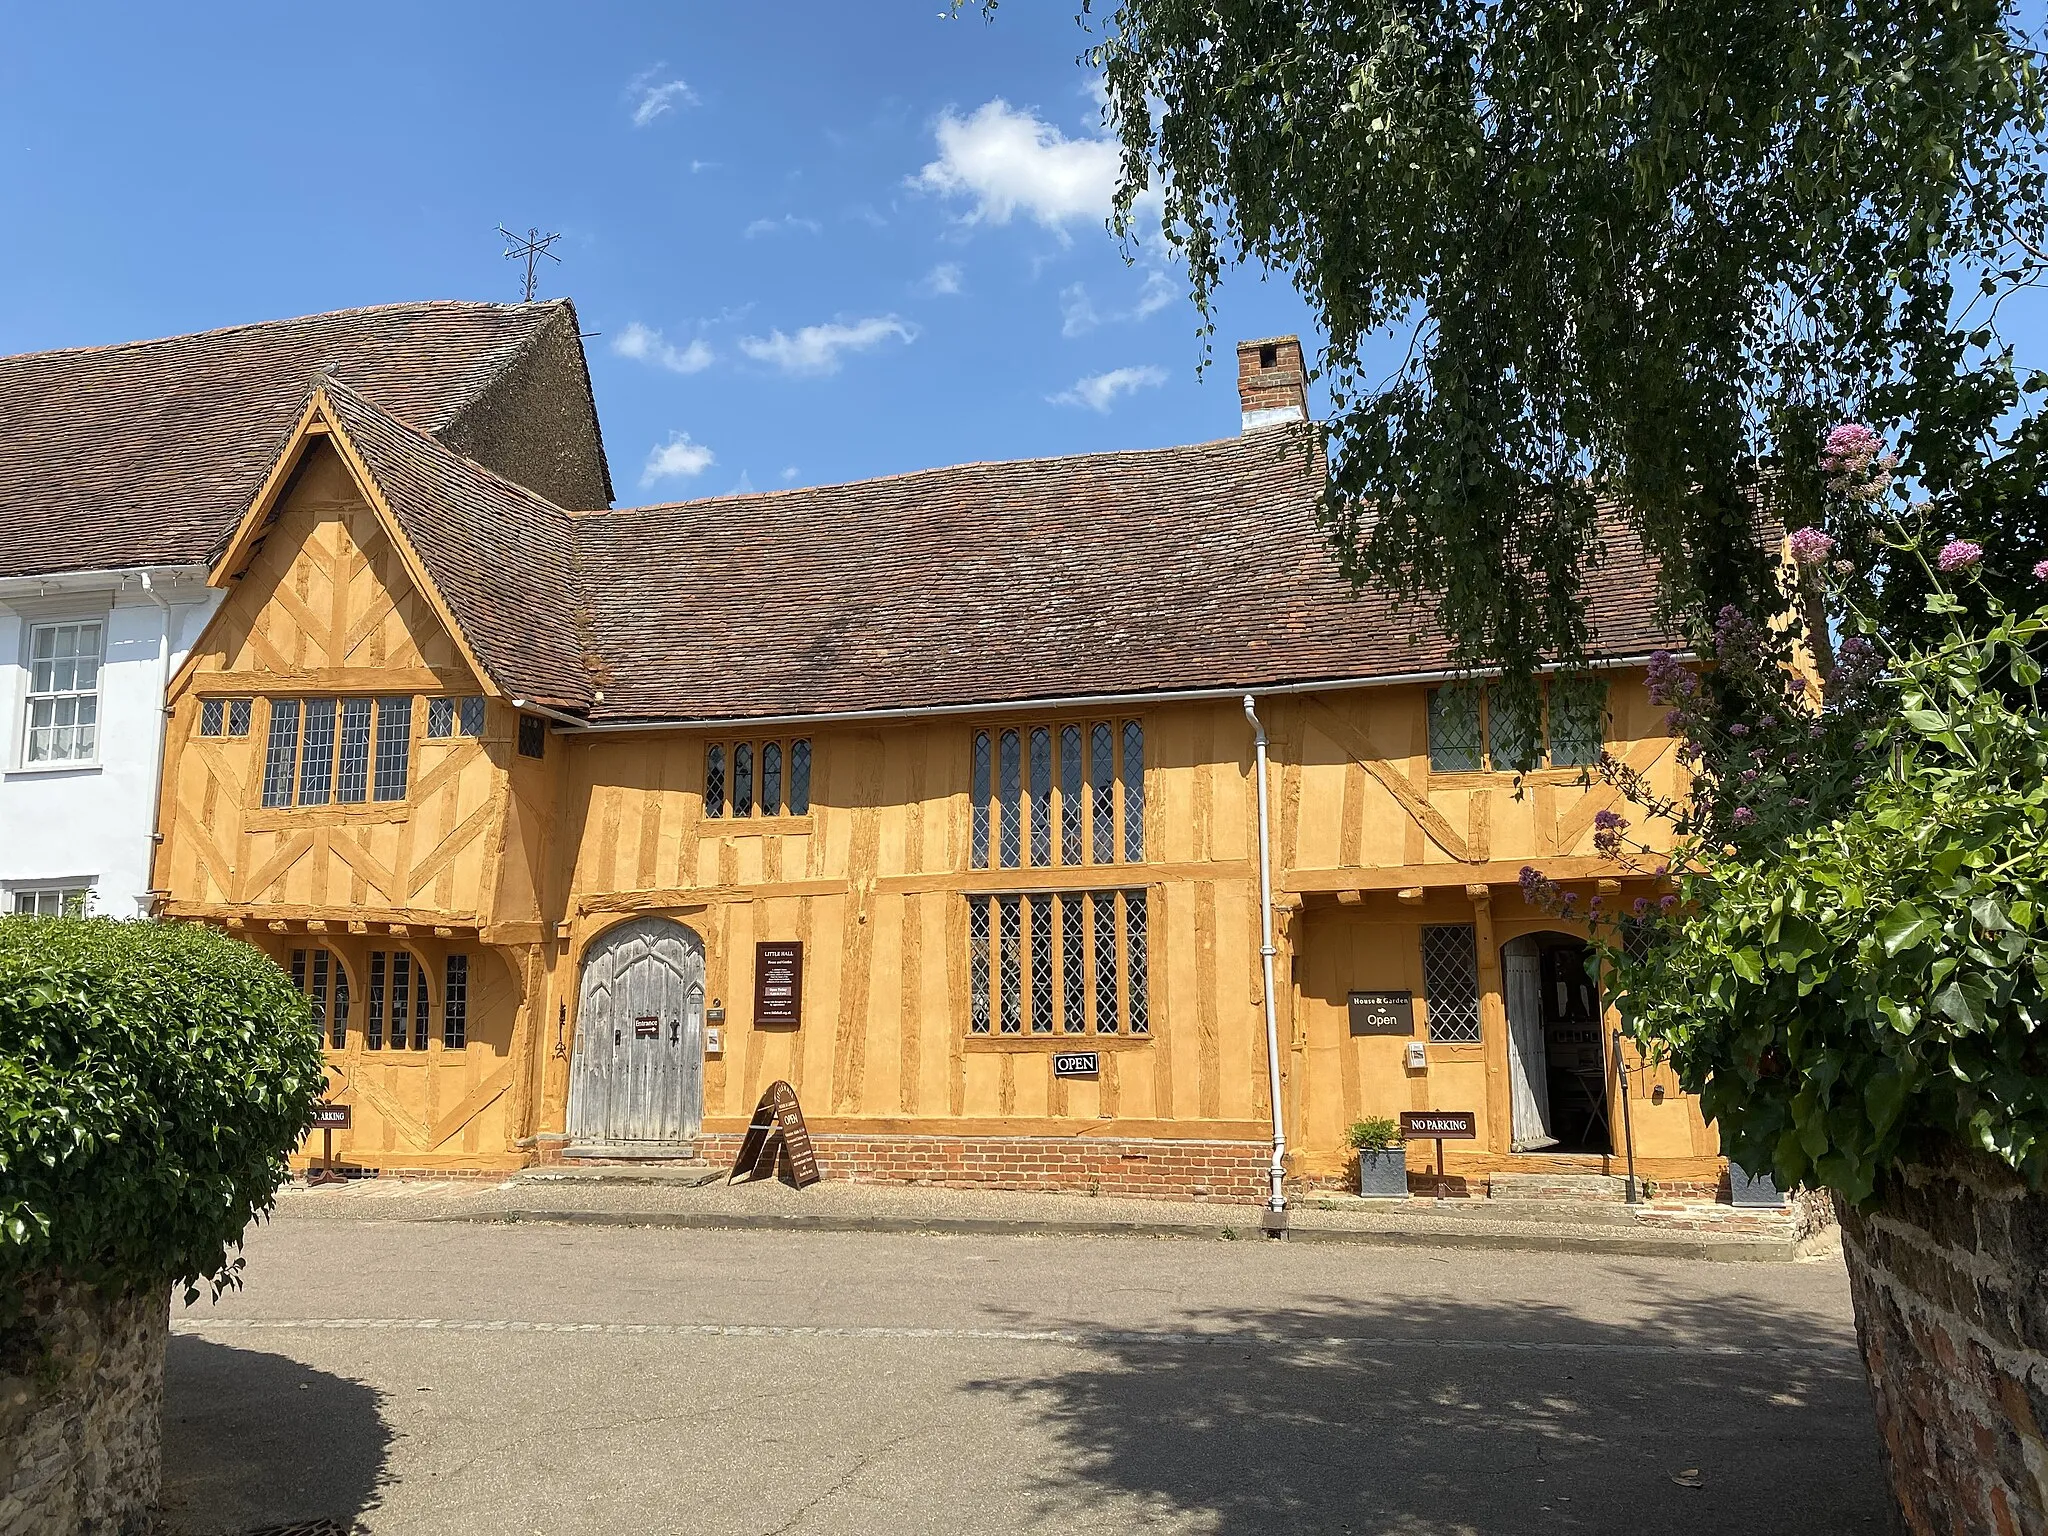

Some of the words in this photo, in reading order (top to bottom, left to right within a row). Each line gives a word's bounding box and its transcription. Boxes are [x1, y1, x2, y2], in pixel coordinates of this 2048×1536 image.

[1367, 1014, 1397, 1027] Open
[1057, 1056, 1094, 1071] OPEN
[318, 1112, 345, 1120] ARKING
[784, 1113, 798, 1126] OPEN
[1410, 1119, 1426, 1130] NO
[1426, 1119, 1467, 1131] PARKING
